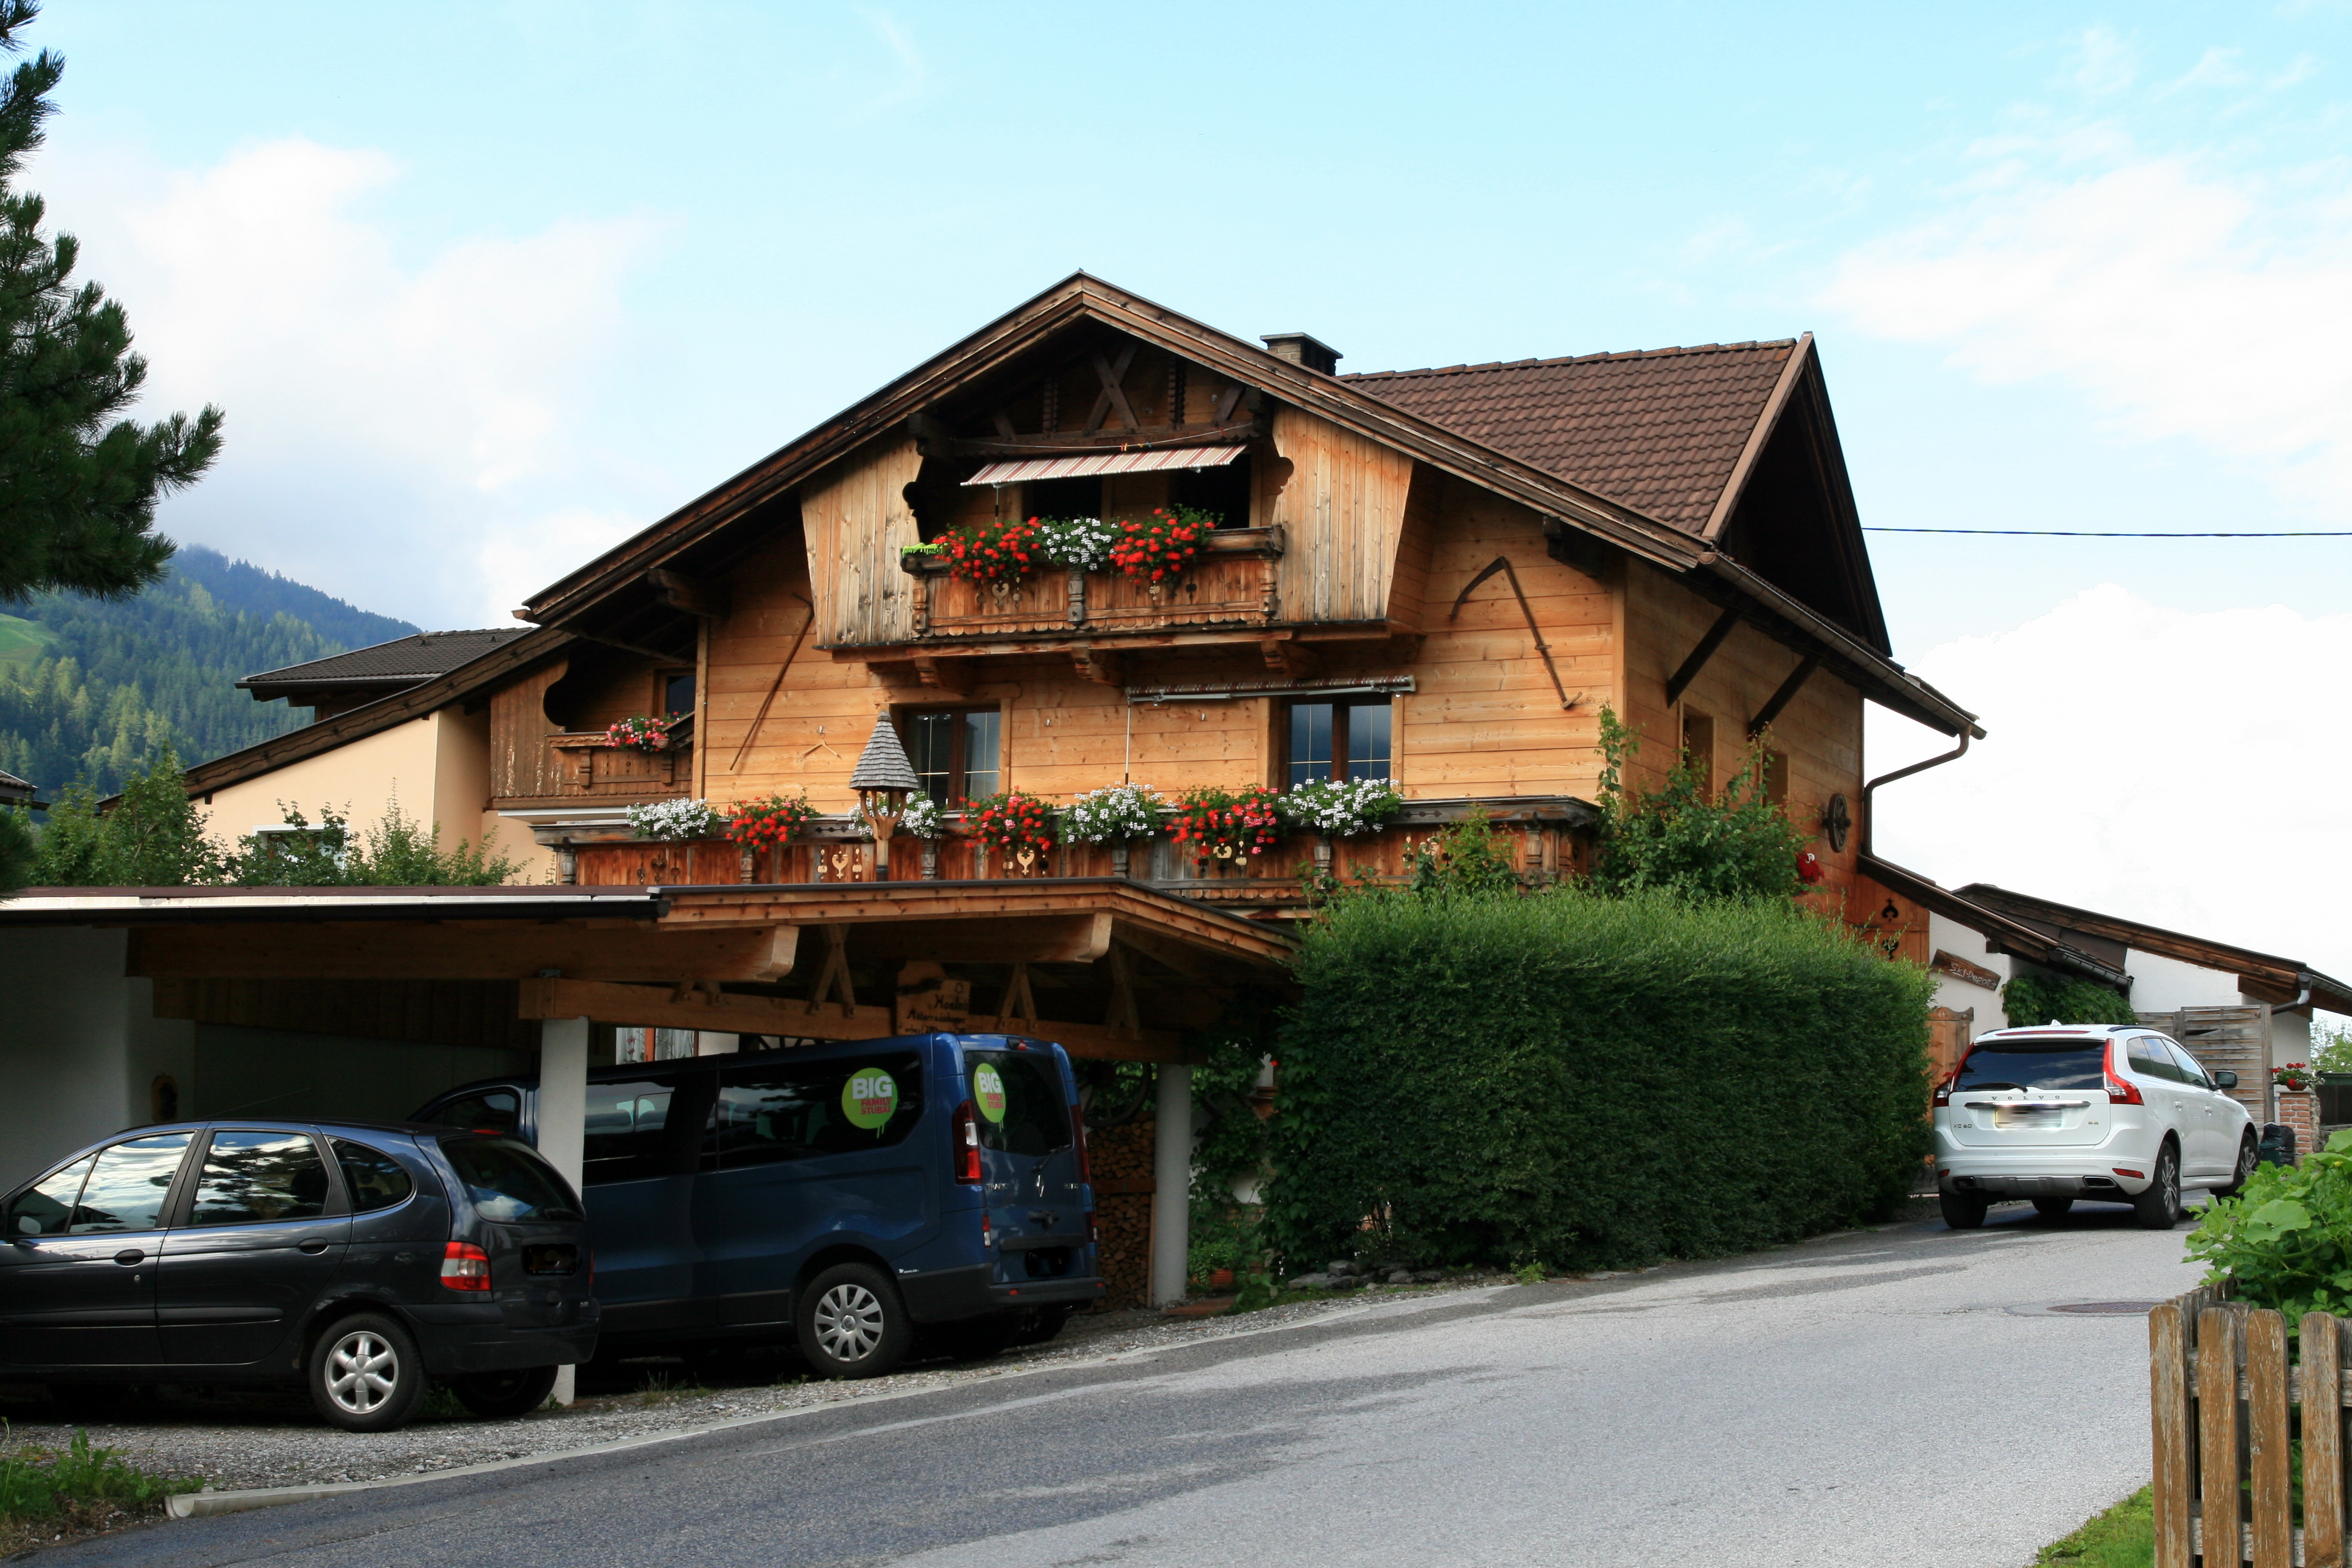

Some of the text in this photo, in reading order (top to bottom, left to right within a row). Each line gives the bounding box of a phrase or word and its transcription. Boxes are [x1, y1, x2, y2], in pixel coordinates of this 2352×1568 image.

[852, 1076, 892, 1100] BIG
[978, 1072, 1002, 1093] BIG
[861, 1097, 892, 1106] FAMILY
[861, 1106, 891, 1115] STUBAI
